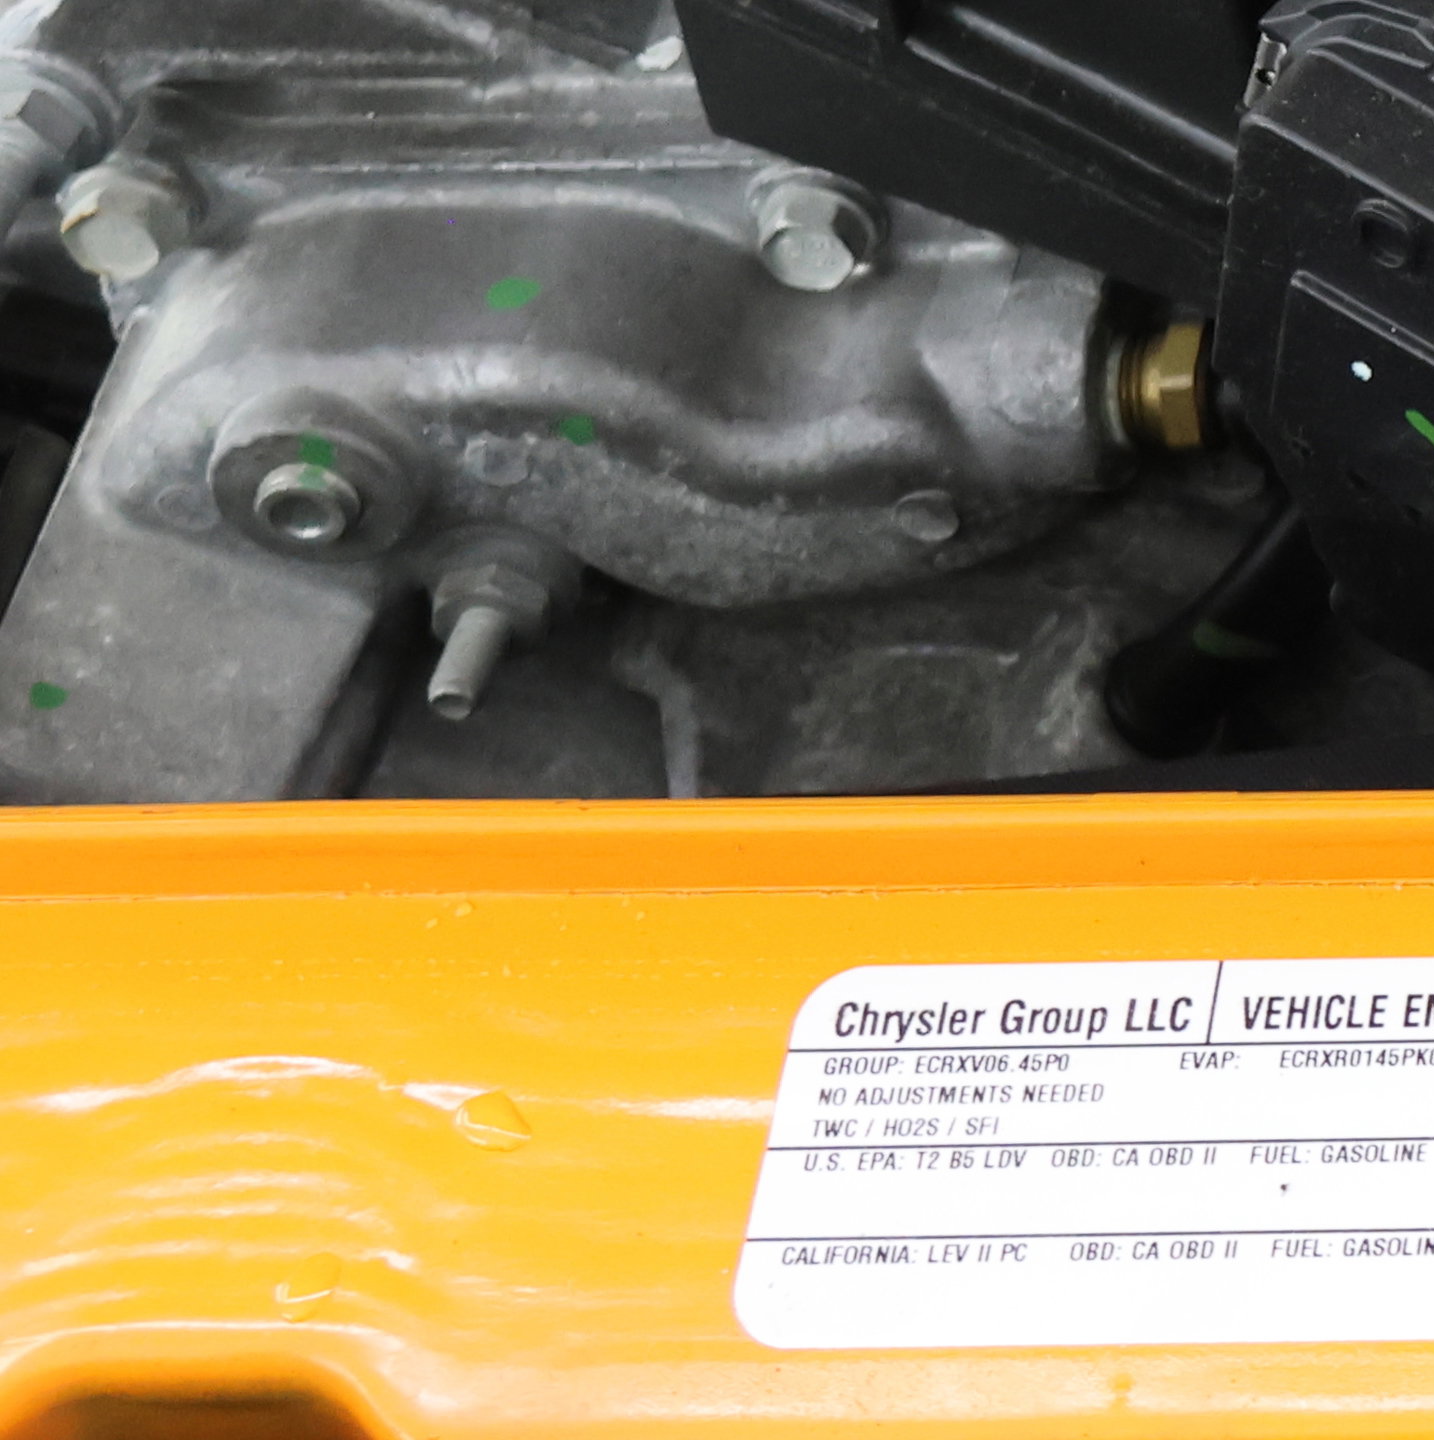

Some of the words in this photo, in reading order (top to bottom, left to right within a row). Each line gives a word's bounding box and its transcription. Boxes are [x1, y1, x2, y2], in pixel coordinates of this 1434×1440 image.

[835, 1002, 986, 1042] Chrysler
[1000, 999, 1108, 1040] Group
[1125, 997, 1192, 1032] LLC
[1244, 994, 1388, 1030] VEHICLE
[824, 1057, 903, 1075] GROUP:
[1180, 1051, 1237, 1069] EVAP:
[819, 1088, 846, 1104] NO
[856, 1086, 1012, 1105] ADJUSTMENTS
[1023, 1084, 1103, 1102] NEEDED
[814, 1120, 857, 1137] TWC
[966, 1118, 998, 1135] SFI
[804, 1153, 843, 1171] U.S.
[858, 1152, 901, 1170] EPA:
[984, 1150, 1026, 1168] LDV
[1052, 1149, 1101, 1167] OBD:
[1113, 1148, 1138, 1166] CA
[1149, 1147, 1193, 1165] OBD
[1204, 1147, 1216, 1164] II
[1251, 1146, 1308, 1164] FUEL:
[1322, 1144, 1425, 1163] GASOLINE
[782, 1246, 915, 1265] CALIFORNIA:
[928, 1245, 968, 1263] LEV
[978, 1245, 991, 1261] II
[1001, 1244, 1027, 1261] PC
[1070, 1242, 1118, 1260] OBD:
[1133, 1242, 1158, 1259] CA
[1170, 1241, 1214, 1259] OBD
[1225, 1241, 1237, 1257] II
[1272, 1239, 1329, 1257] FUEL:
